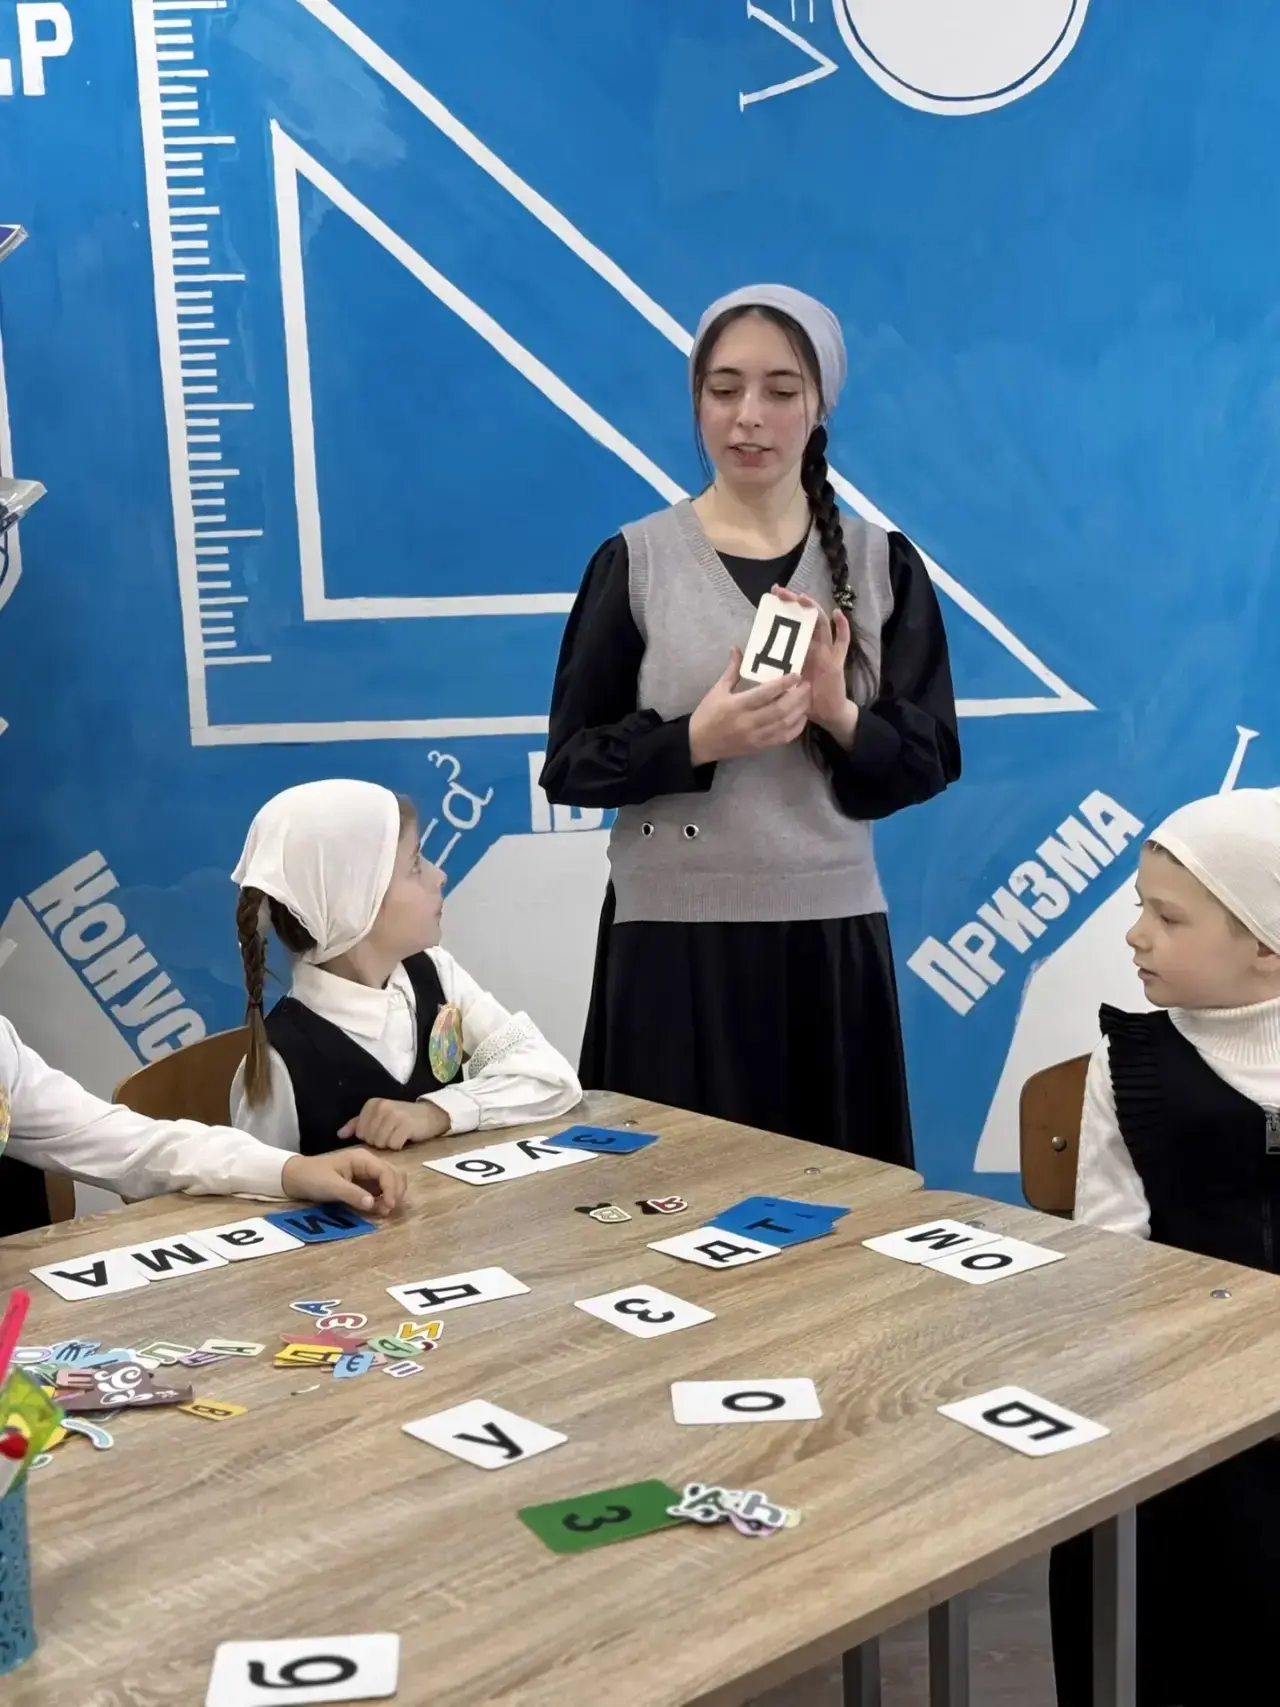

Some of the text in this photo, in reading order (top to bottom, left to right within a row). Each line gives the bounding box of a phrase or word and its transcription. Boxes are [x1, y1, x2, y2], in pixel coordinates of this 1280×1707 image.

[0, 2, 73, 96] Р
[750, 614, 802, 676] Д
[27, 850, 206, 1062] КОНУС
[907, 790, 1144, 1016] ПРИЗМА
